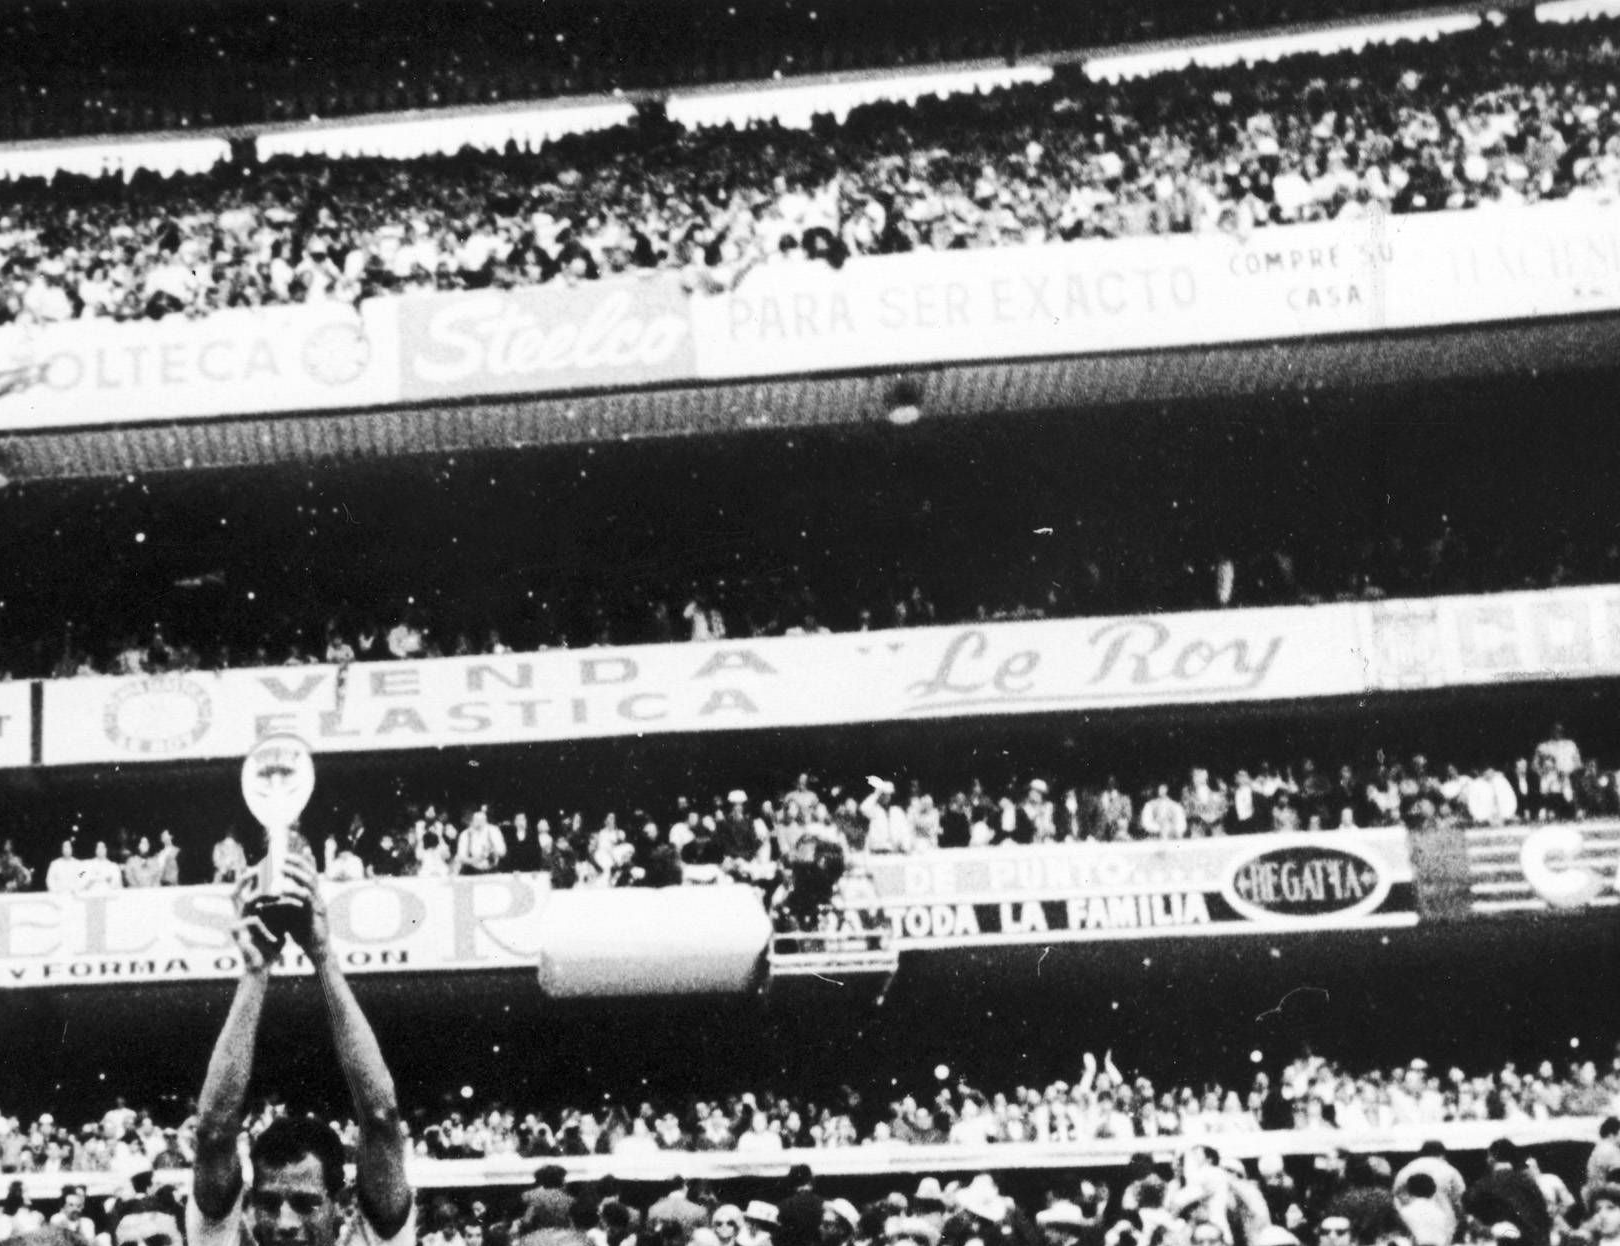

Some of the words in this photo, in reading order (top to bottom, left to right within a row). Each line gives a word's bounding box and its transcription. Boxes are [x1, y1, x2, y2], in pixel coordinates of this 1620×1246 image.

[1230, 244, 1340, 278] COMPRE
[729, 292, 856, 342] PARA
[880, 282, 971, 330] SER
[991, 264, 1198, 324] EXACTO
[1287, 284, 1362, 312] CASA
[413, 290, 686, 382] Steelco
[10, 337, 282, 392] OLTECA
[256, 648, 780, 702] VENDA
[904, 629, 1042, 698] Le
[1086, 616, 1284, 692] Roy
[254, 688, 761, 741] ELASTICA
[903, 864, 956, 896] DE
[886, 903, 980, 937] TODA
[1000, 900, 1048, 934] LA
[1068, 890, 1210, 931] FAMILIA
[42, 958, 190, 979] FORMA
